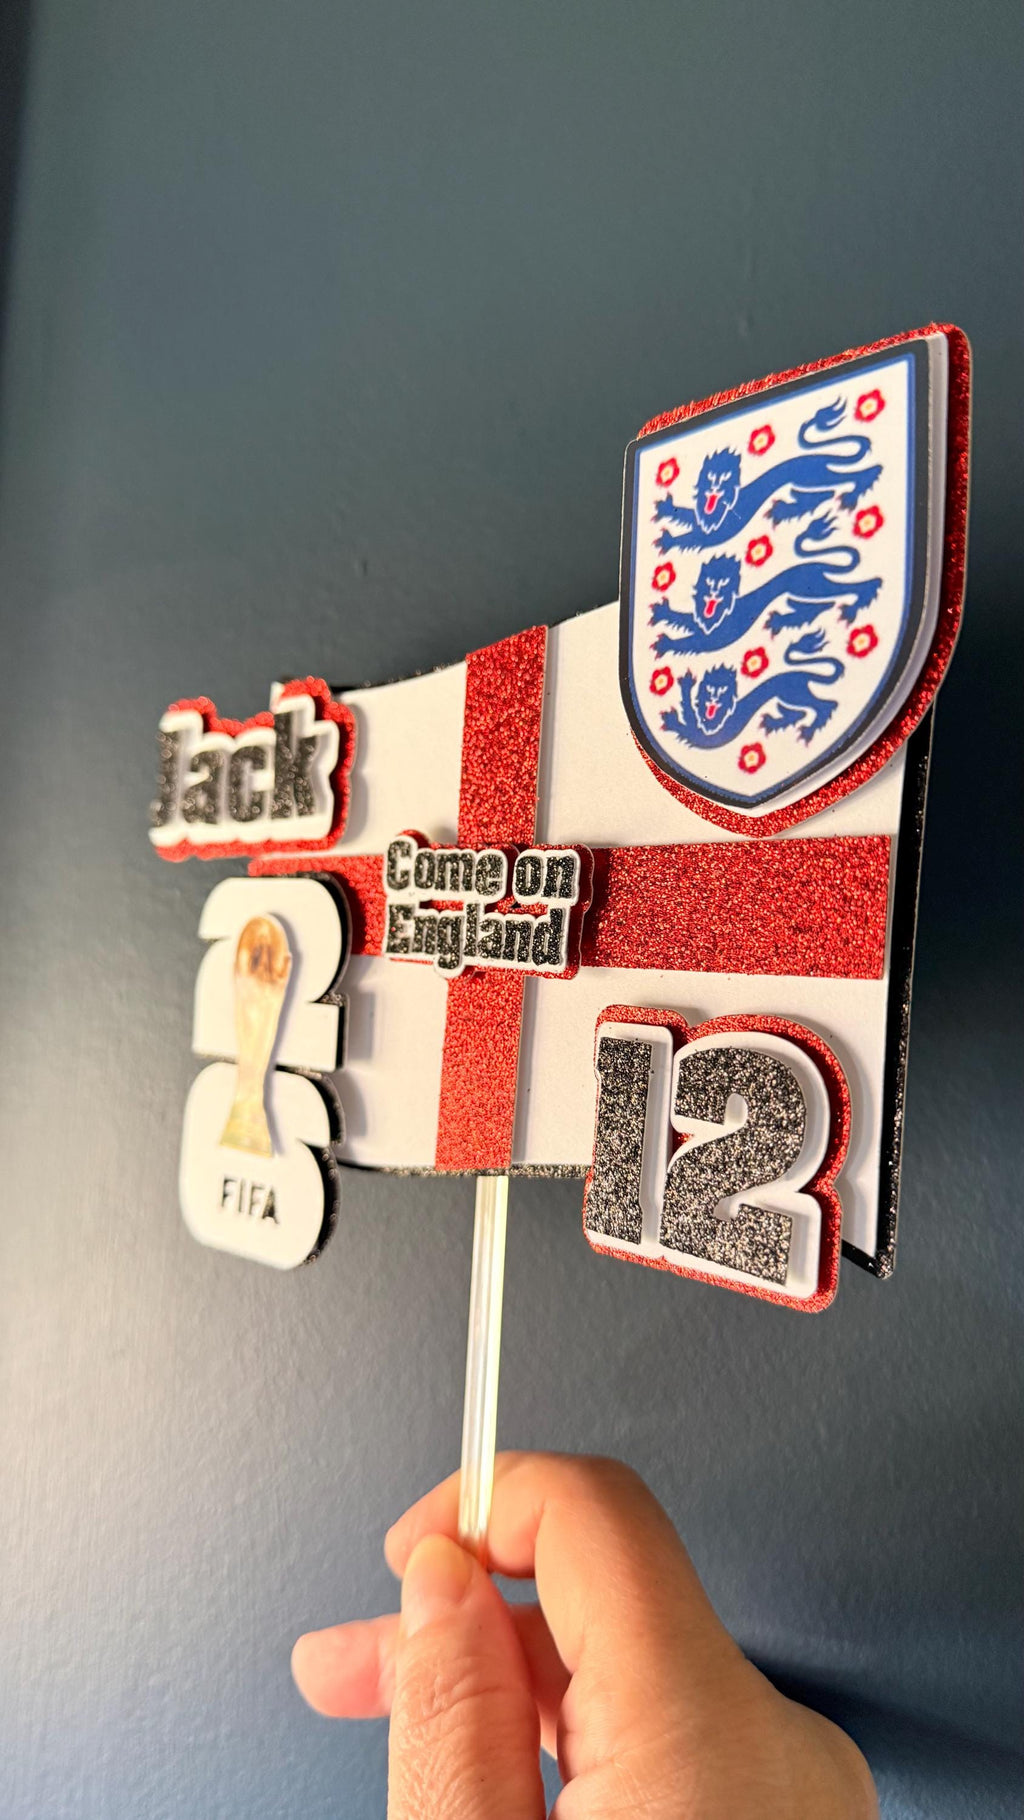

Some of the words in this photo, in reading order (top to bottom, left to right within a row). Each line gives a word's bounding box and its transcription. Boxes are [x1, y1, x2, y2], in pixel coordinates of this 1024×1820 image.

[150, 711, 319, 827] Jack
[386, 839, 504, 897] Come
[514, 855, 576, 899] on
[385, 902, 564, 971] England
[584, 1035, 807, 1287] 12
[219, 1173, 280, 1226] FIFA
